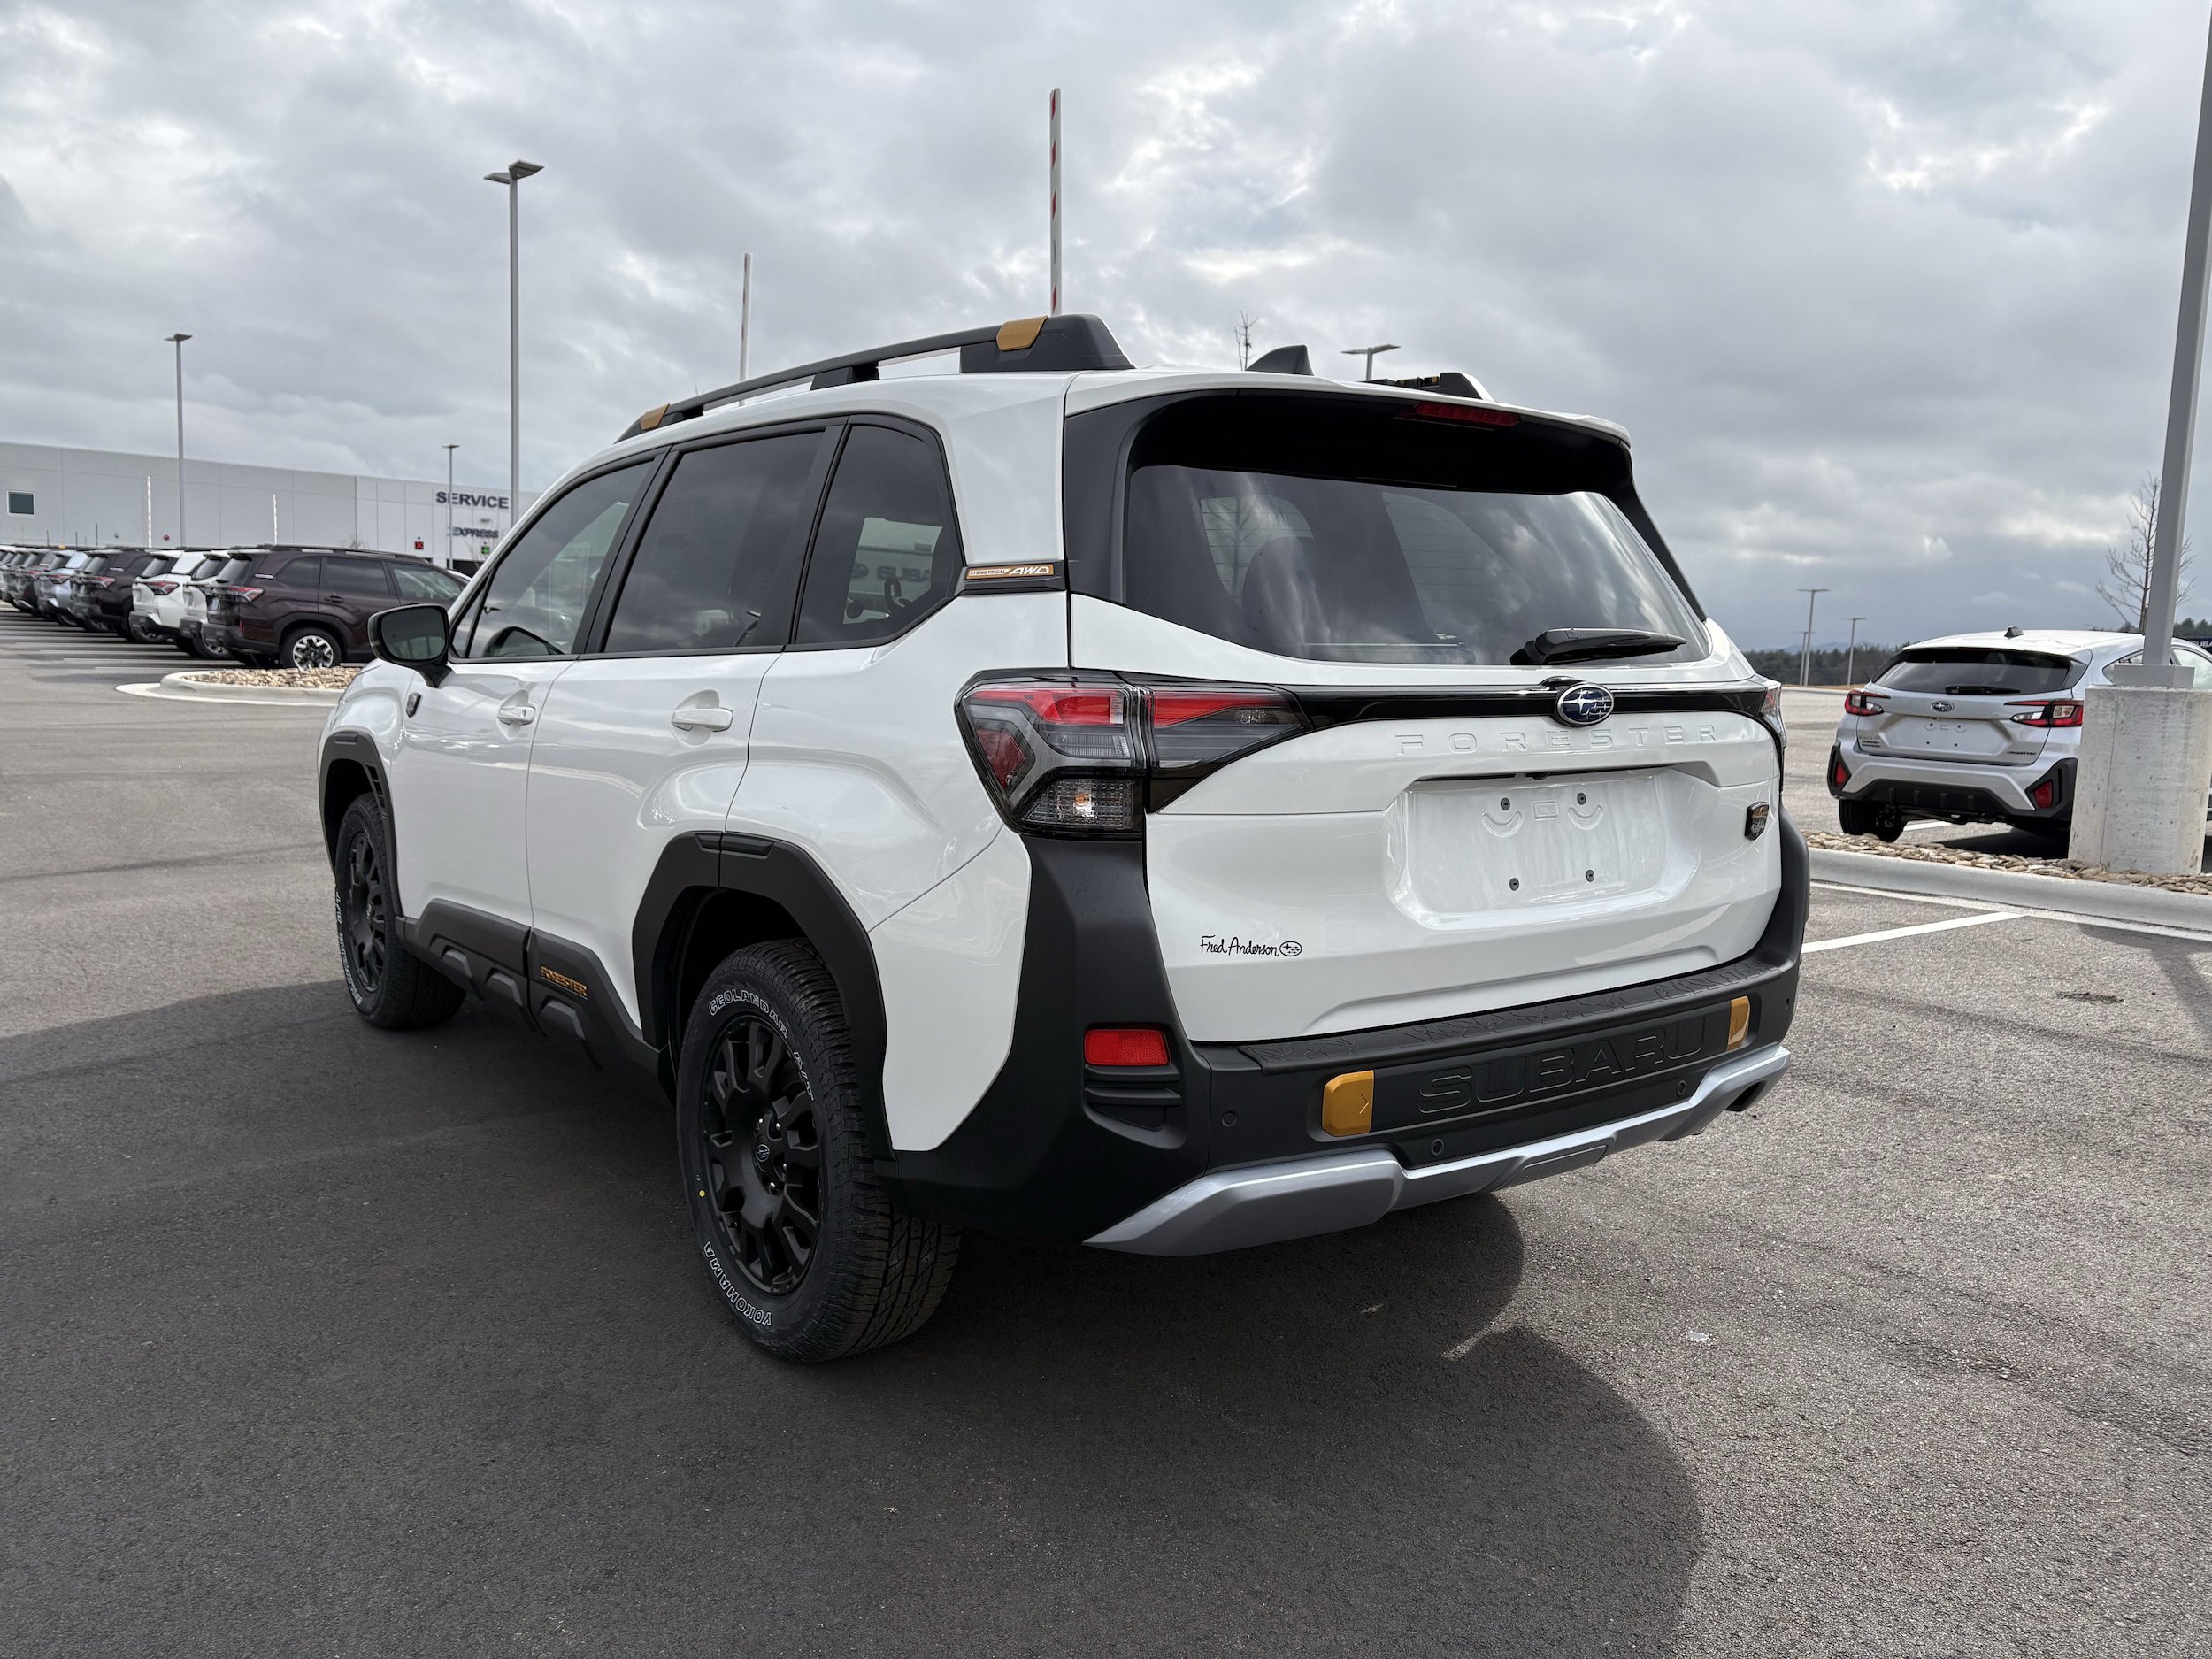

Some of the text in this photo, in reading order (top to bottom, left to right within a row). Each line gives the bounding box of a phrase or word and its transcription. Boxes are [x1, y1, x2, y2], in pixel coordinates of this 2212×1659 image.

[436, 491, 510, 509] SERVICE
[447, 526, 499, 538] EXPRESS
[1009, 565, 1050, 575] AWD
[1395, 724, 1718, 756] FORESTER
[1200, 934, 1279, 956] Fred Anderson
[541, 966, 587, 996] FORESTER
[709, 989, 814, 1101] GEOLANDAR A/T
[1418, 1017, 1706, 1114] SUBARU
[703, 1241, 772, 1325] YOKOHAMA
